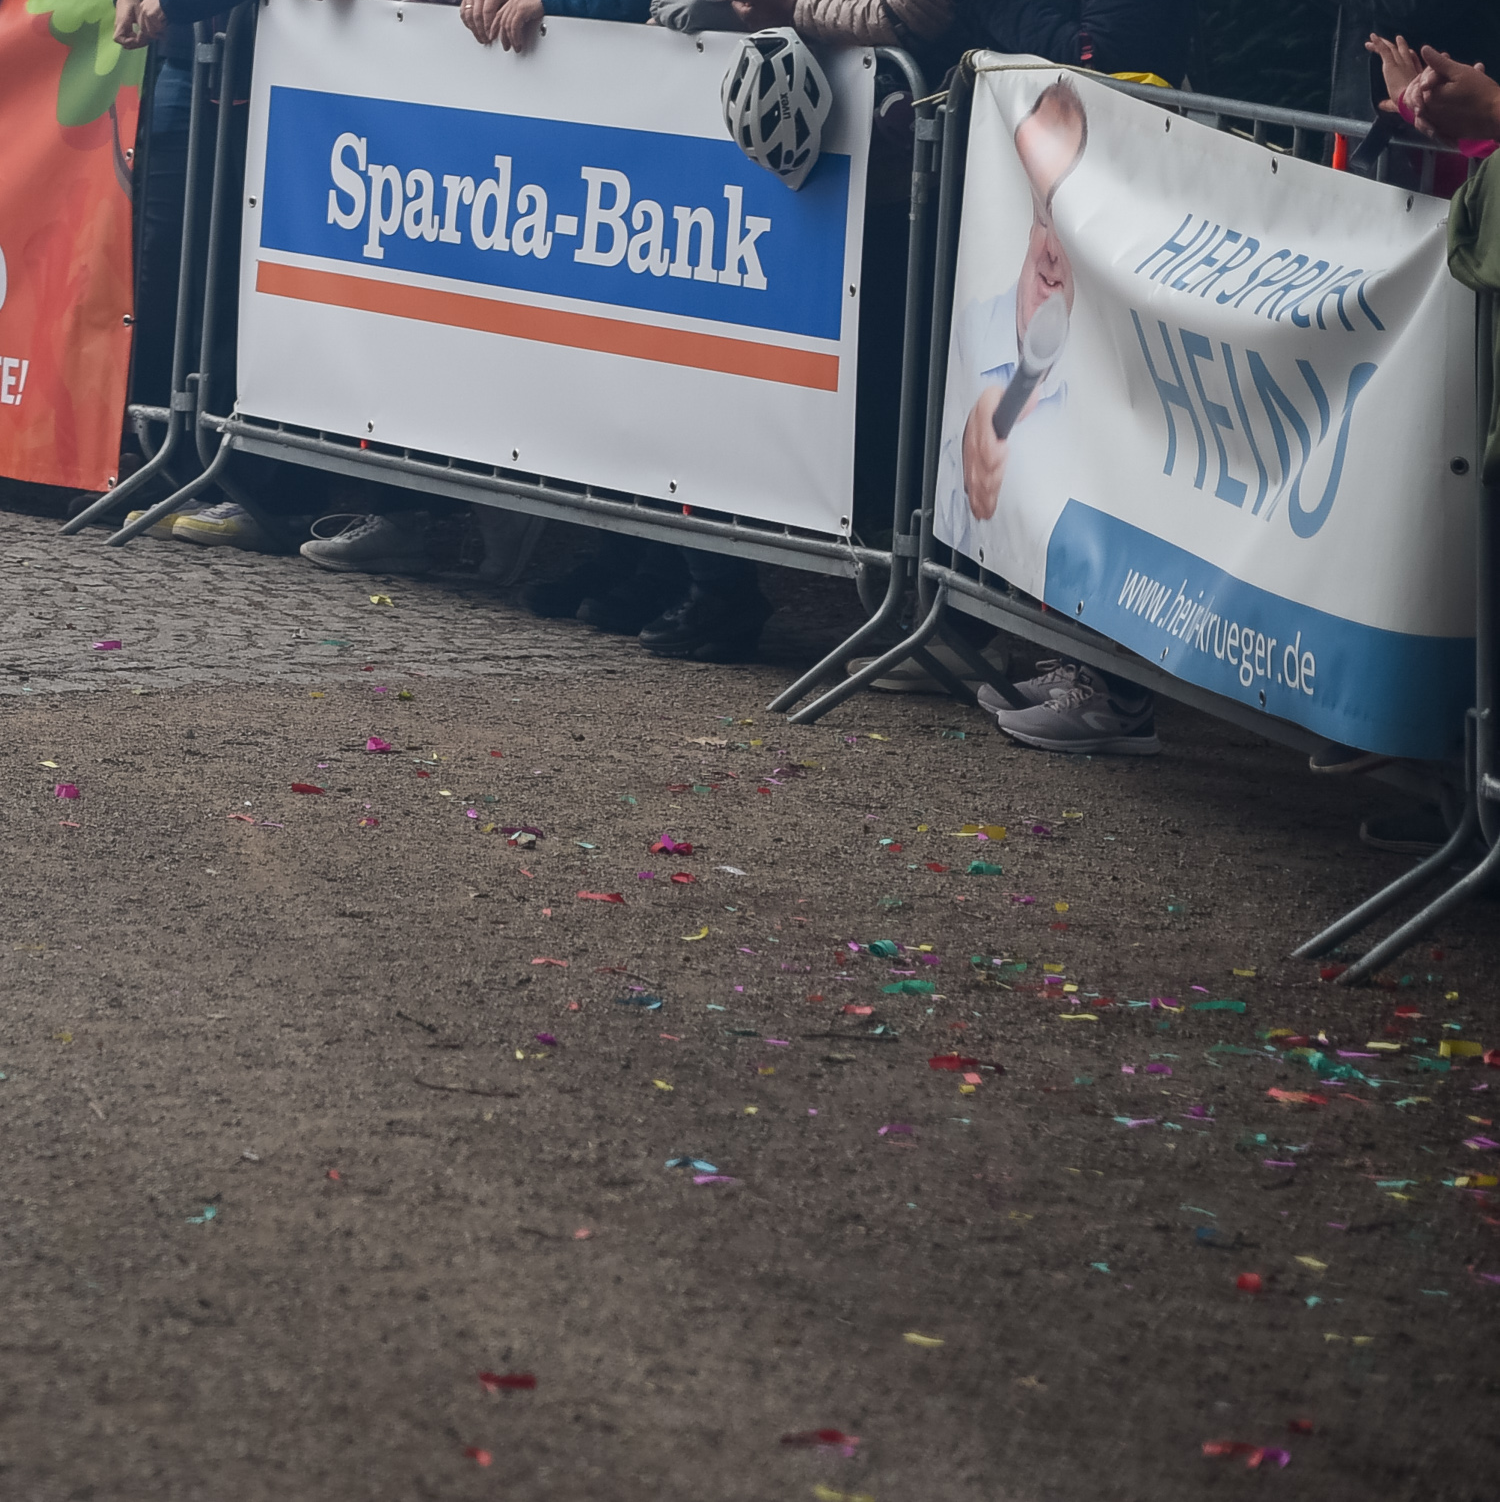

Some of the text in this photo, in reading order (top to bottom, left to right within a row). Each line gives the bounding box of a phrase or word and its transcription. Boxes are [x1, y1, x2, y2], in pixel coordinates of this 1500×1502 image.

[780, 92, 791, 120] uvex
[327, 132, 771, 290] Sparda-Bank
[1134, 213, 1261, 298] HIER
